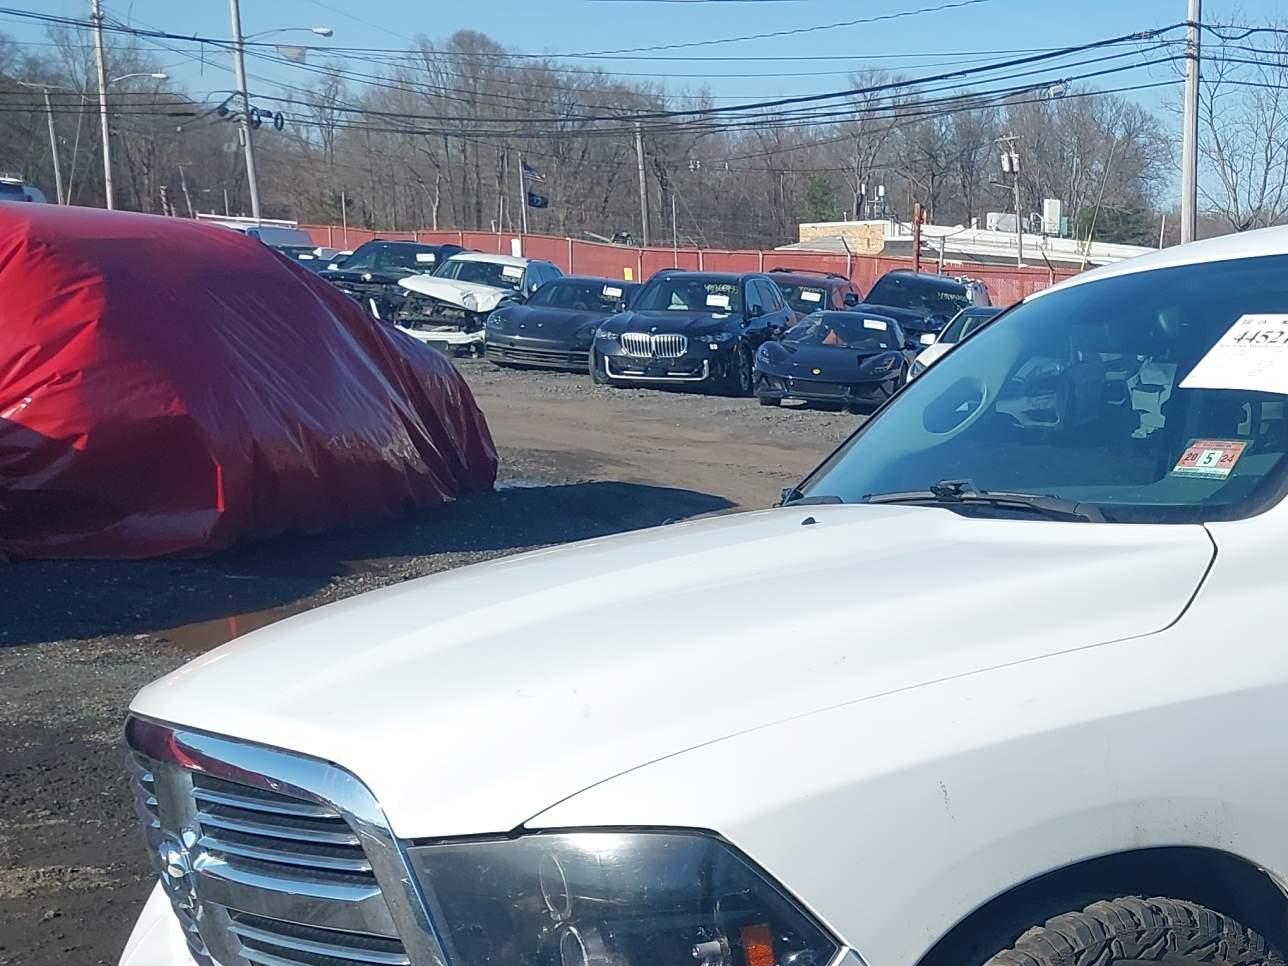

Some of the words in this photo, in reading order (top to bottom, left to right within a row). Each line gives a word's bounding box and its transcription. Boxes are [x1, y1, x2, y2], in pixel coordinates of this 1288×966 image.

[1184, 453, 1198, 462] 20
[1203, 453, 1215, 465] 5
[1221, 455, 1235, 464] 24
